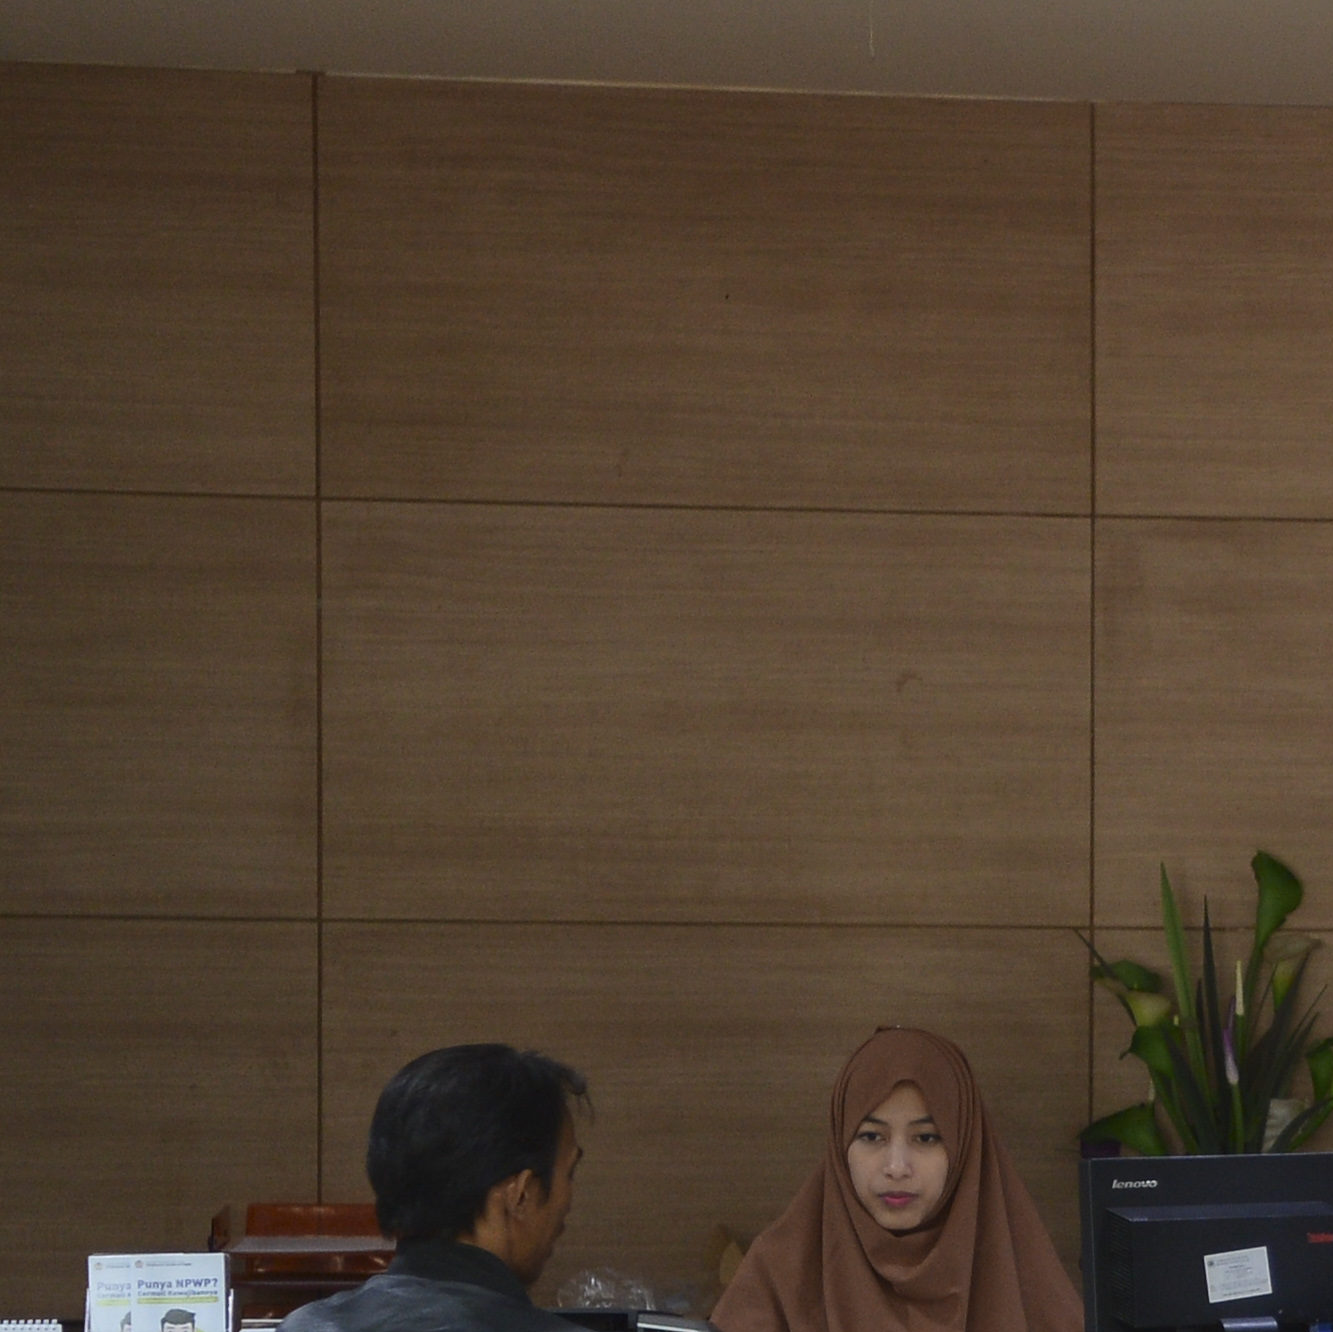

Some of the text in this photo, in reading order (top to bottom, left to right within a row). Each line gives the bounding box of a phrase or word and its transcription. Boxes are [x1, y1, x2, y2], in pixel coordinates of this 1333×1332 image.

[1112, 1179, 1158, 1189] lenovo
[137, 1278, 219, 1290] Punya NPWP?
